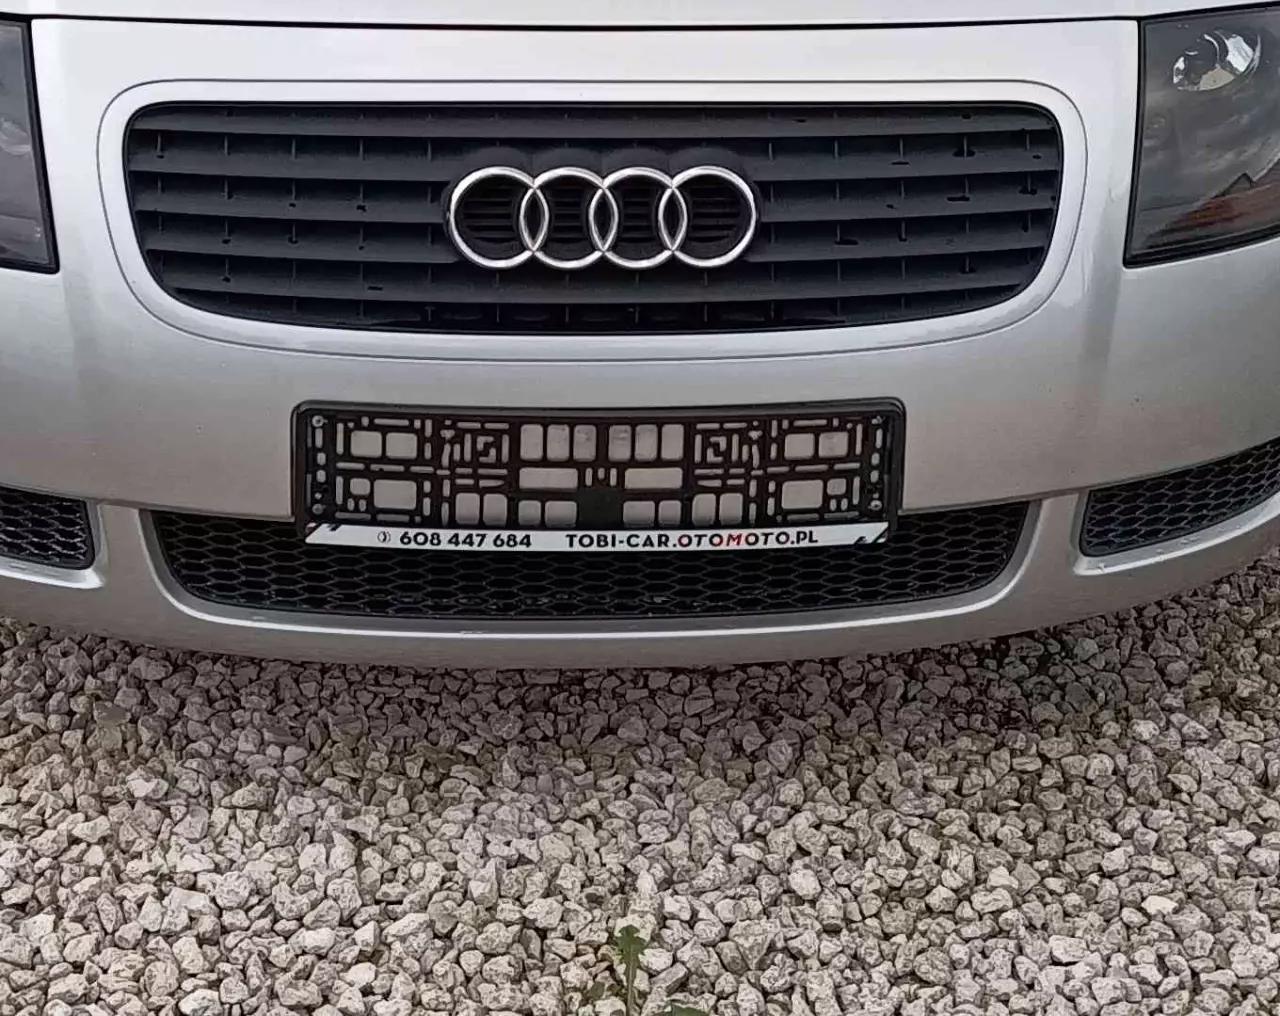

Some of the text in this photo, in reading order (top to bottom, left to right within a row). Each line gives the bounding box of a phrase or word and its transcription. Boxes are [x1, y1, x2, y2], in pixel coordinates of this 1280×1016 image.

[399, 529, 819, 549] 608 447 684 TOBI-CAR.OTOMOTO.PL
